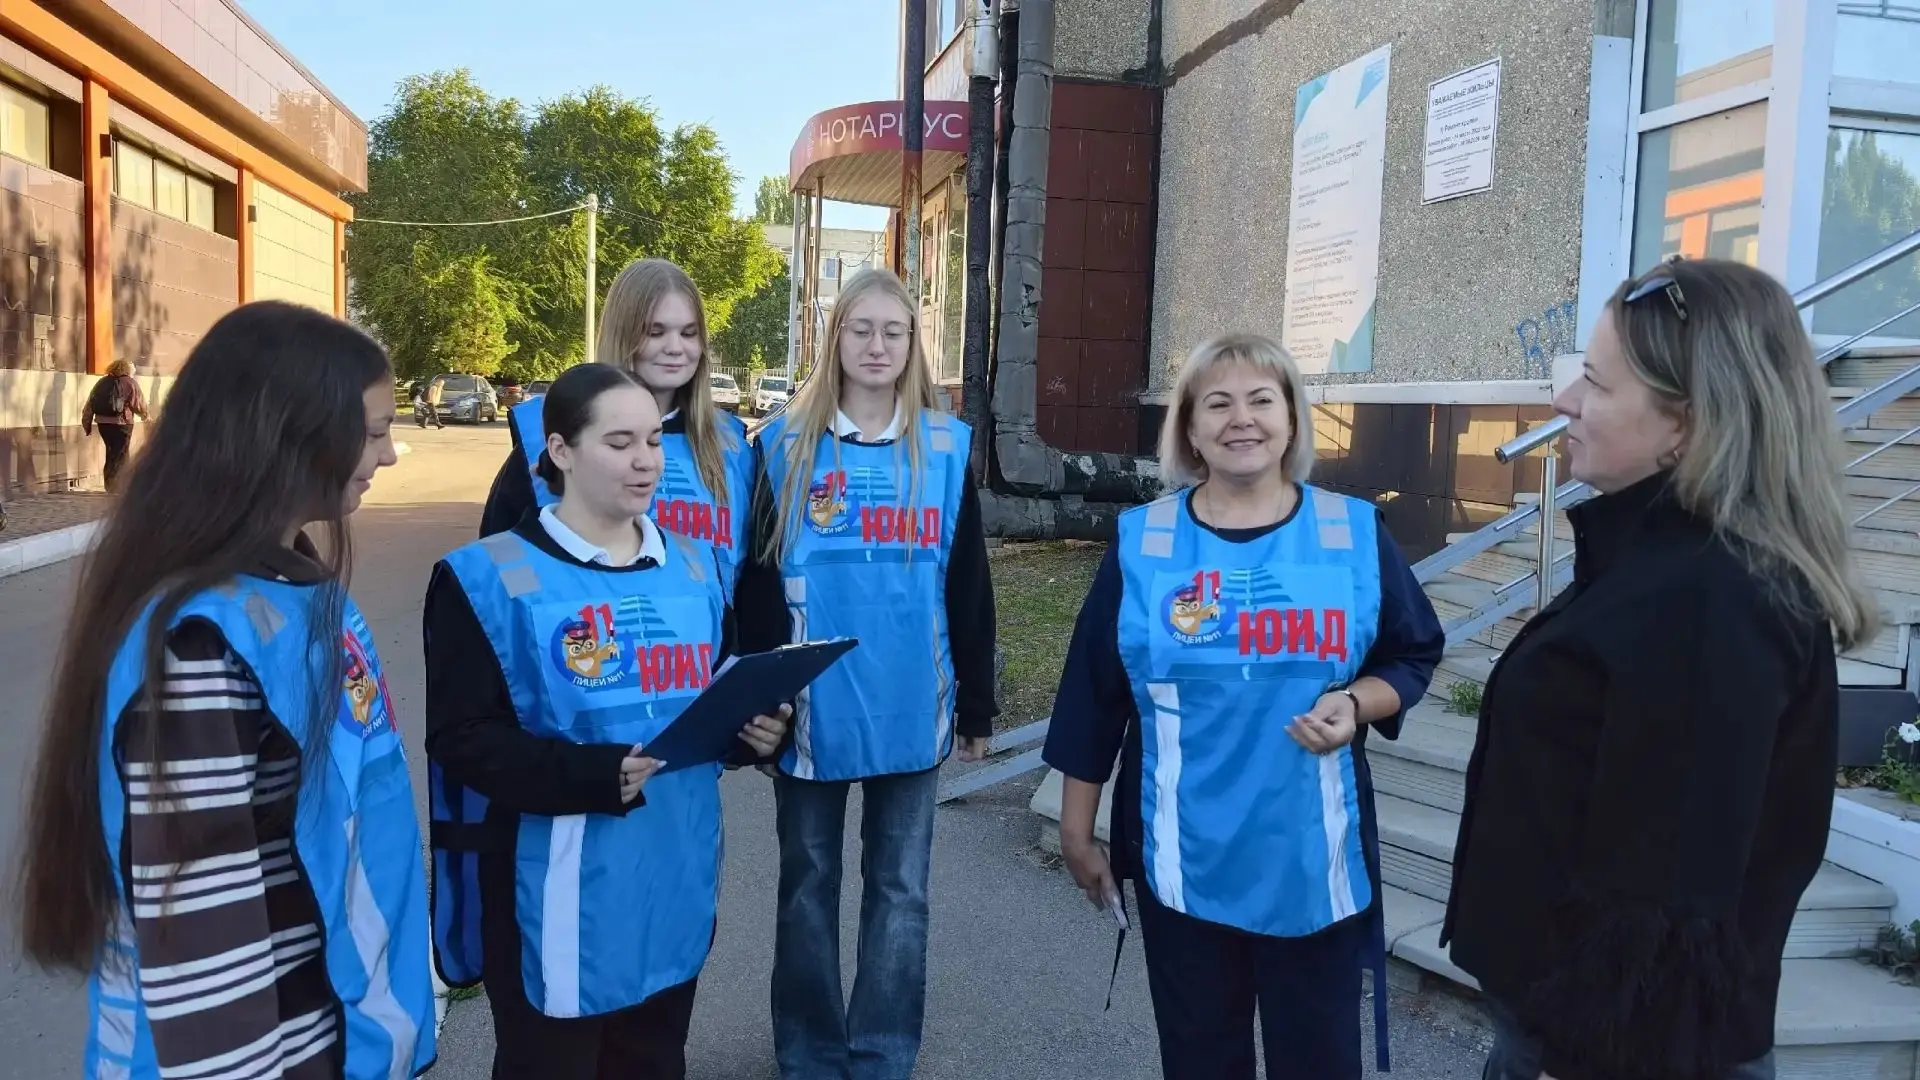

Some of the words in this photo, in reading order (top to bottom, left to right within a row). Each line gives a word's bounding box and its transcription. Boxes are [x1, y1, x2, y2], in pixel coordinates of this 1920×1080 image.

[820, 112, 963, 147] НОТАРУС
[656, 499, 733, 550] ЮИД
[860, 505, 940, 548] ЮИД
[1192, 570, 1221, 602] 11
[577, 603, 615, 641] 11
[1238, 608, 1348, 663] ЮИД
